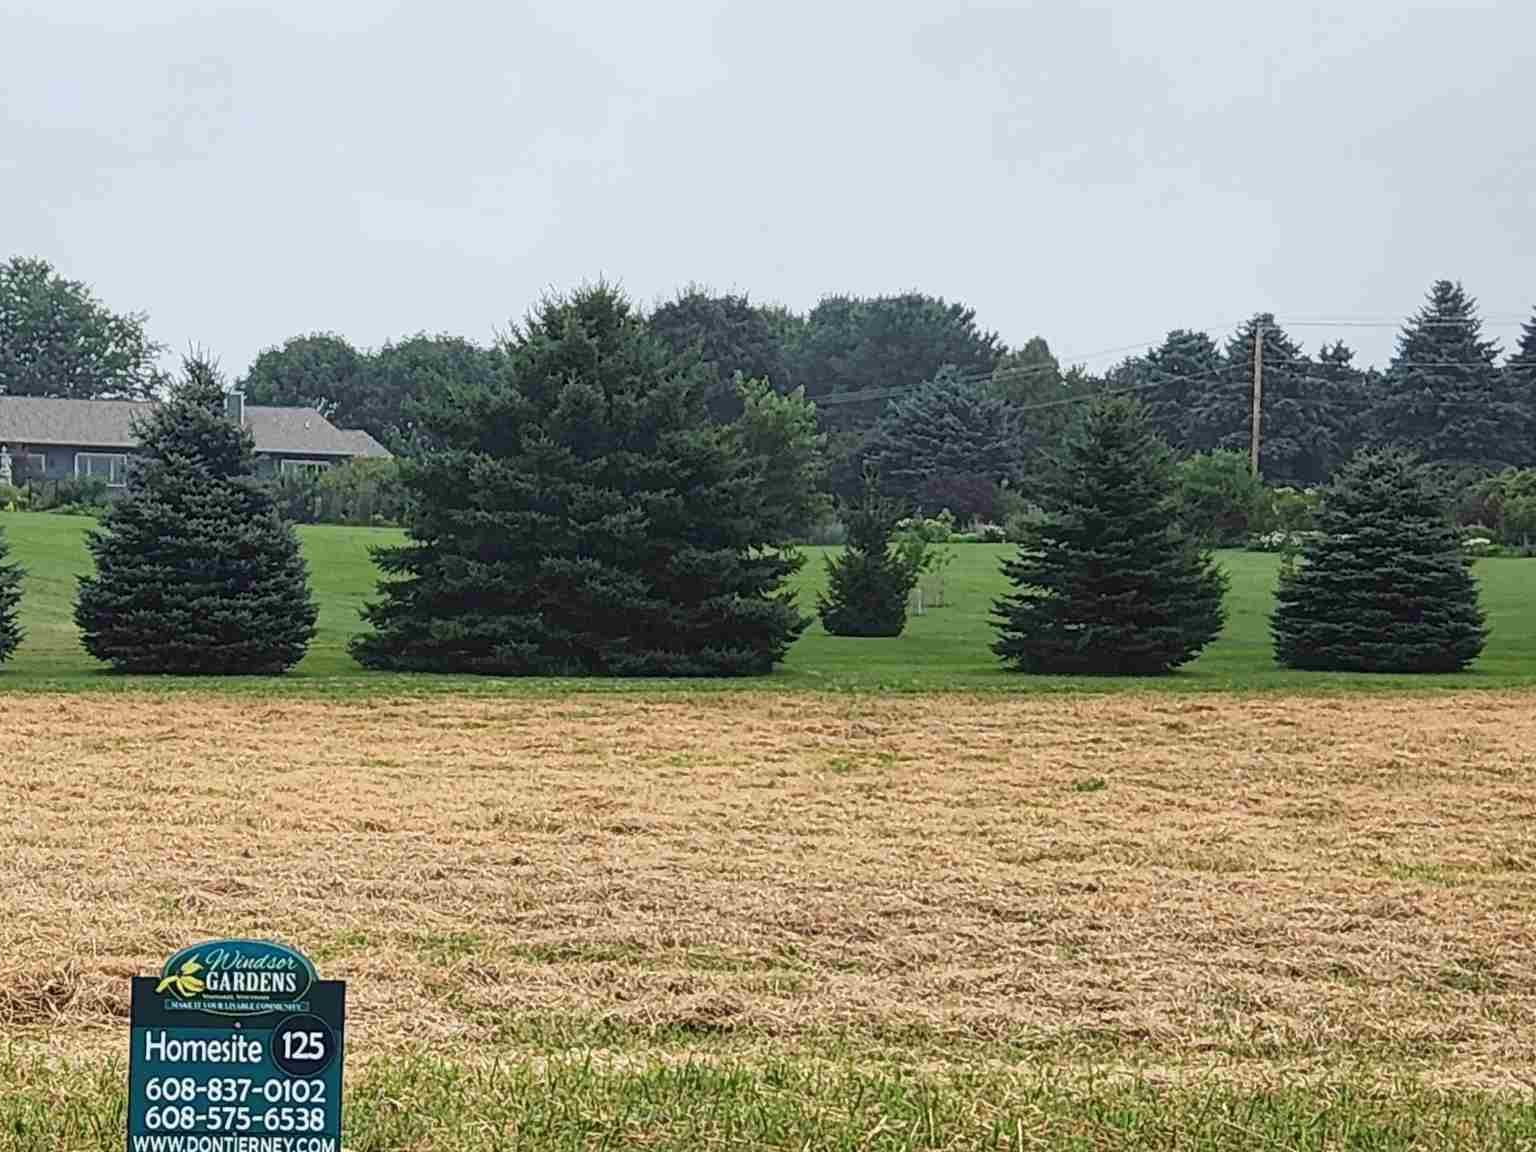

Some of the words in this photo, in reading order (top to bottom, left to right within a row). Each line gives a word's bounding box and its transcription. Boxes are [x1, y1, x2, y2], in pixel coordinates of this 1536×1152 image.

[205, 948, 298, 971] Windsor
[206, 971, 297, 992] GARDENS
[144, 1031, 263, 1063] Homesite
[281, 1031, 325, 1061] 125
[145, 1077, 326, 1103] 608-837-0102
[145, 1106, 325, 1131] 608-575-6538
